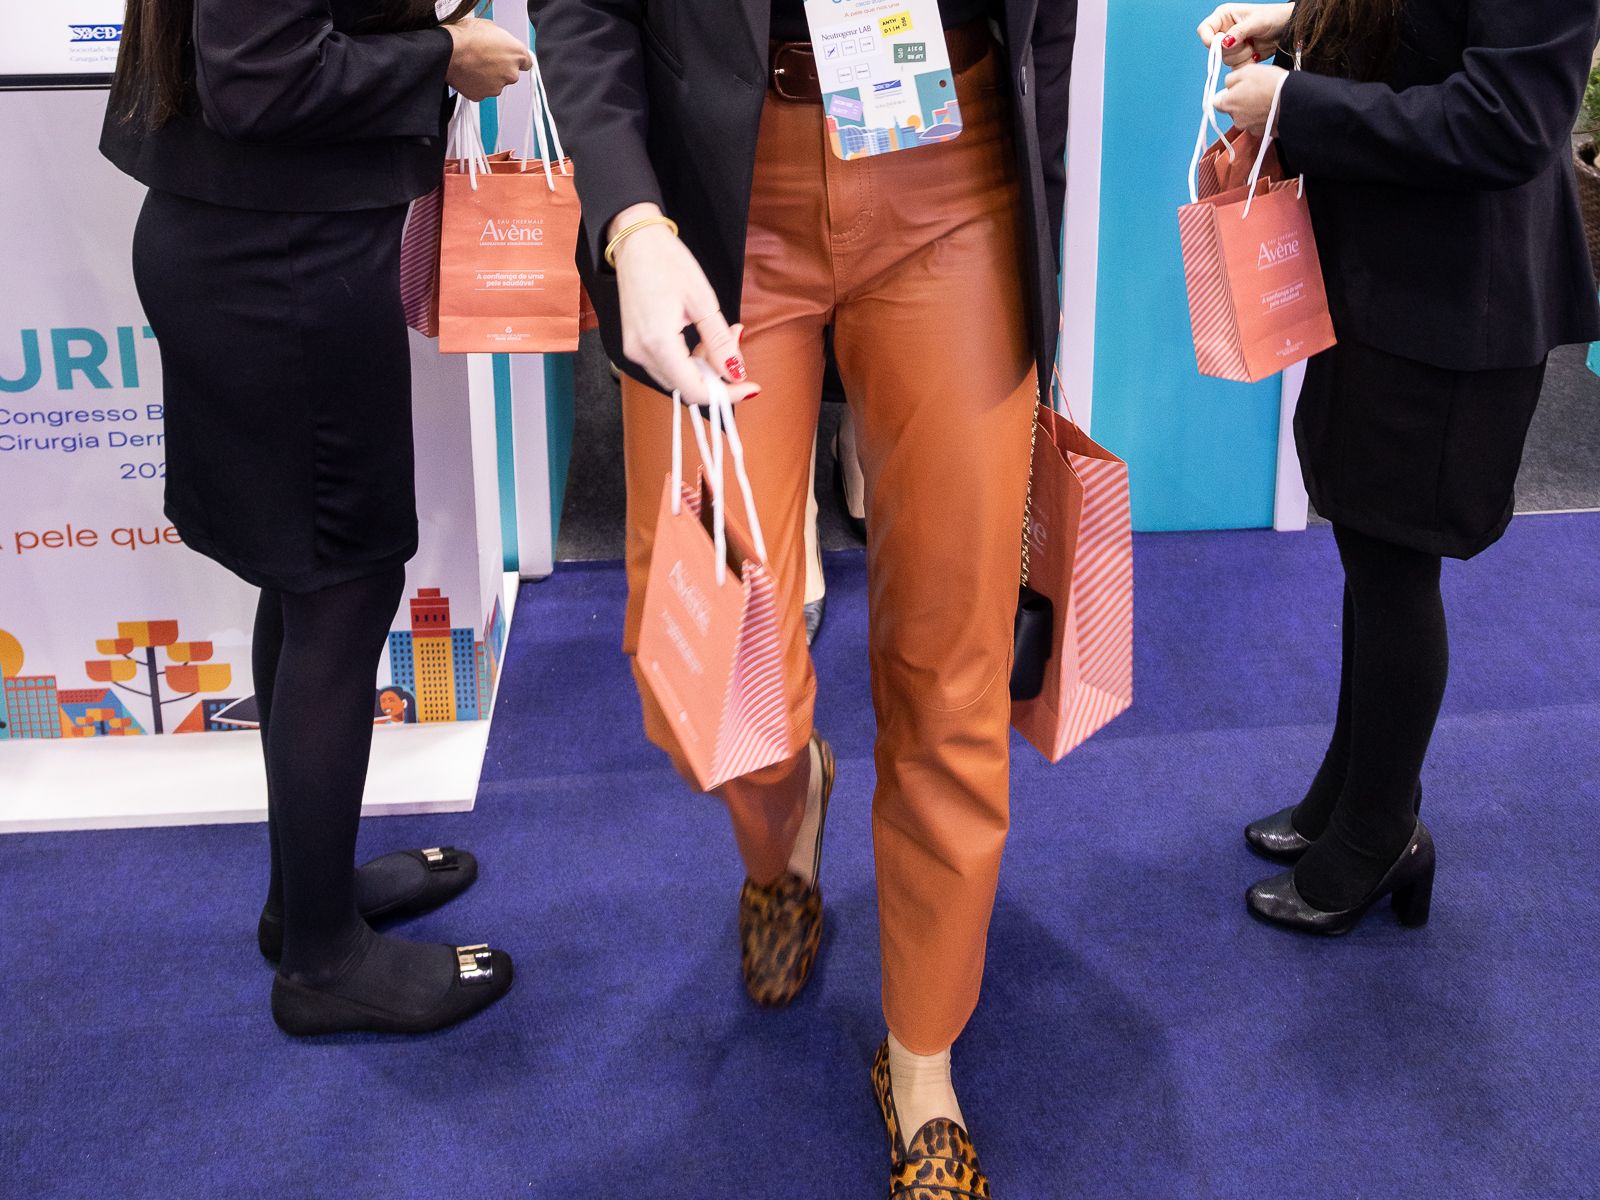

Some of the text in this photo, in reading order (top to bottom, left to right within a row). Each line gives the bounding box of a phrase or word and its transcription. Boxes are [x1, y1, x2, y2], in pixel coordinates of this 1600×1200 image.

[480, 219, 543, 241] Avène
[1257, 239, 1299, 266] Avène
[0, 408, 137, 427] Congresso
[0, 433, 99, 453] Cirurgia
[15, 523, 183, 555] pele que
